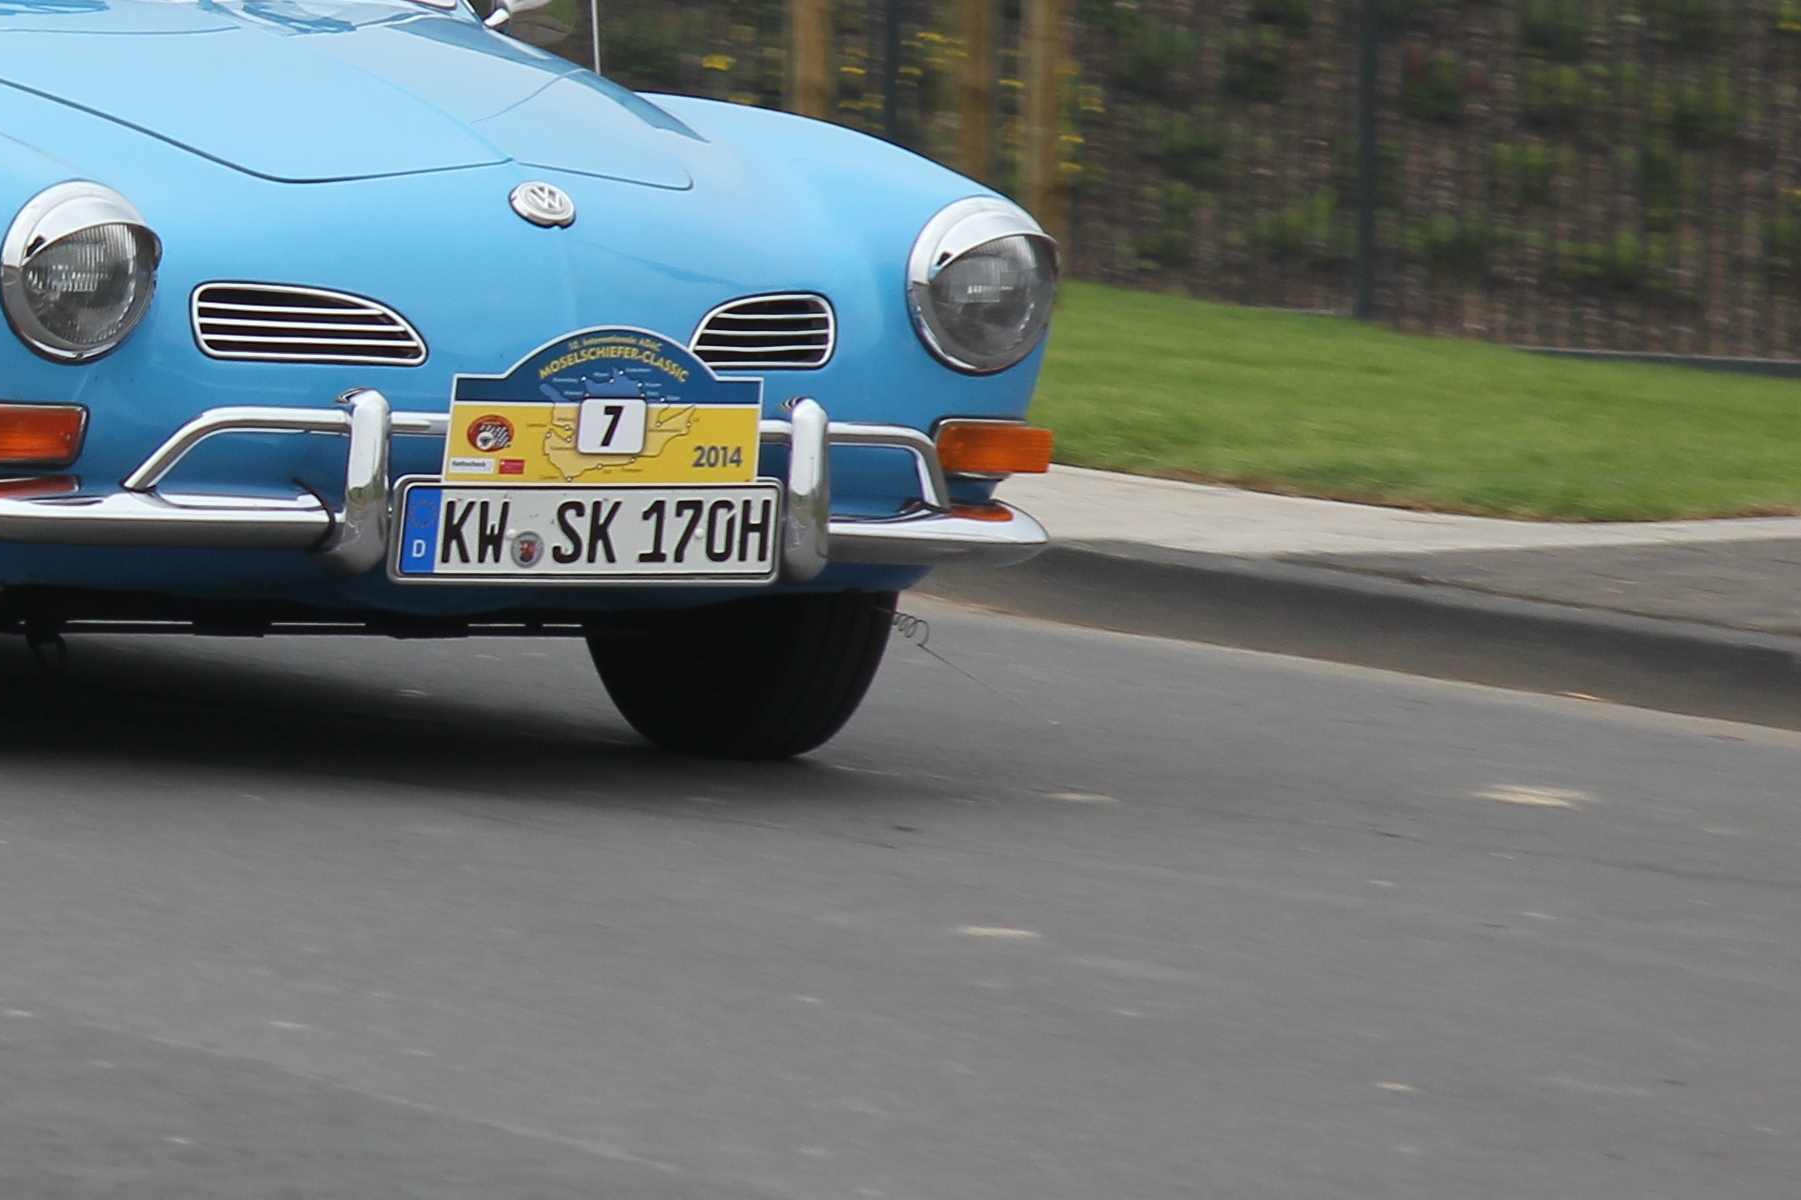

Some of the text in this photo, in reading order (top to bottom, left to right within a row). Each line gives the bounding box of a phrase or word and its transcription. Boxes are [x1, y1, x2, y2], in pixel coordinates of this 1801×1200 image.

[538, 345, 690, 383] MOSELSCHIEFER-CLASSIC
[599, 405, 625, 447] 7
[692, 445, 743, 469] 2014
[411, 539, 427, 559] D
[552, 499, 622, 564] SK
[639, 499, 771, 563] 170H
